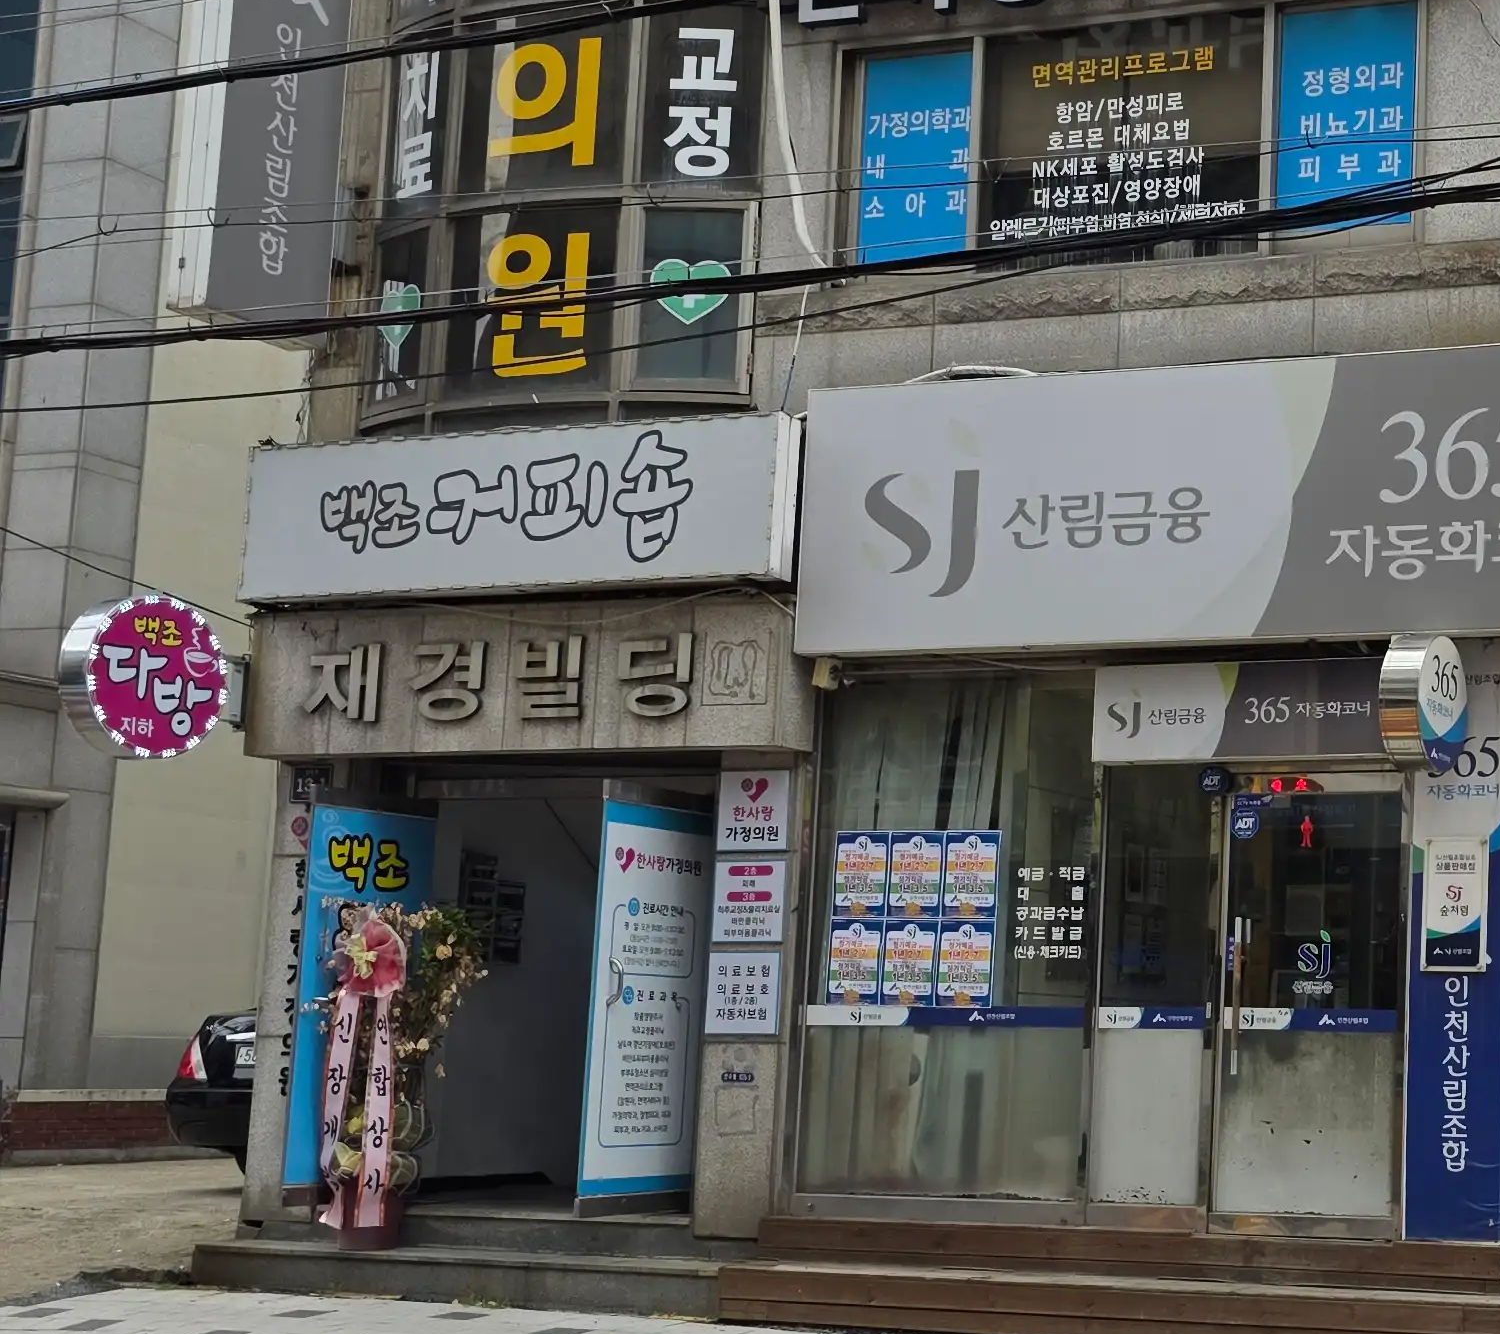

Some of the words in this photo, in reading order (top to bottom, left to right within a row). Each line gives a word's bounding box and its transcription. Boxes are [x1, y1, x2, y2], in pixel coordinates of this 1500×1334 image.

[1032, 45, 1215, 89] 면역관리프로그램
[1302, 63, 1404, 97] 정형외과
[663, 26, 738, 177] 교정
[1055, 92, 1184, 124] 항암/만성피로
[869, 106, 971, 136] 가정의학과
[1046, 126, 1105, 151] 호르몬
[1113, 118, 1191, 146] 대체요법
[1300, 105, 1404, 138] 비뇨기과
[259, 23, 302, 275] 인천산림조합
[1032, 156, 1099, 179] NK세포
[1106, 145, 1205, 174] 활성도검사
[1298, 148, 1402, 184] 피부과
[1033, 173, 1201, 209] 대상포진/영양장애
[320, 478, 420, 554] 백조
[426, 429, 693, 563] 커피숍
[1001, 486, 1211, 551] 산림금융
[133, 615, 184, 647] 백조
[103, 642, 214, 737] 다방
[302, 631, 694, 724] 재경빌딩
[1431, 655, 1459, 701] 365
[119, 714, 155, 739] 지하
[1148, 706, 1207, 727] 산림금융
[1243, 696, 1291, 725] 365
[1295, 698, 1372, 720] 자동화코너
[1203, 774, 1221, 787] ADT
[1426, 783, 1500, 802] 자동화코너
[732, 805, 774, 822] 한사랑
[1234, 817, 1255, 831] ADT
[725, 824, 779, 843] 가정의원
[328, 833, 410, 894] 백조
[637, 852, 702, 876] 한사랑가정의원
[1015, 906, 1086, 922] 공과금수납
[1440, 904, 1469, 917] 숲처럼
[1014, 926, 1083, 943] 카드발급
[717, 965, 770, 978] 의료보험
[716, 983, 770, 996] 의료보호
[715, 1008, 768, 1021] 자동차보험
[1441, 975, 1470, 1174] 인천산림조합
[363, 1013, 391, 1195] 연합상사
